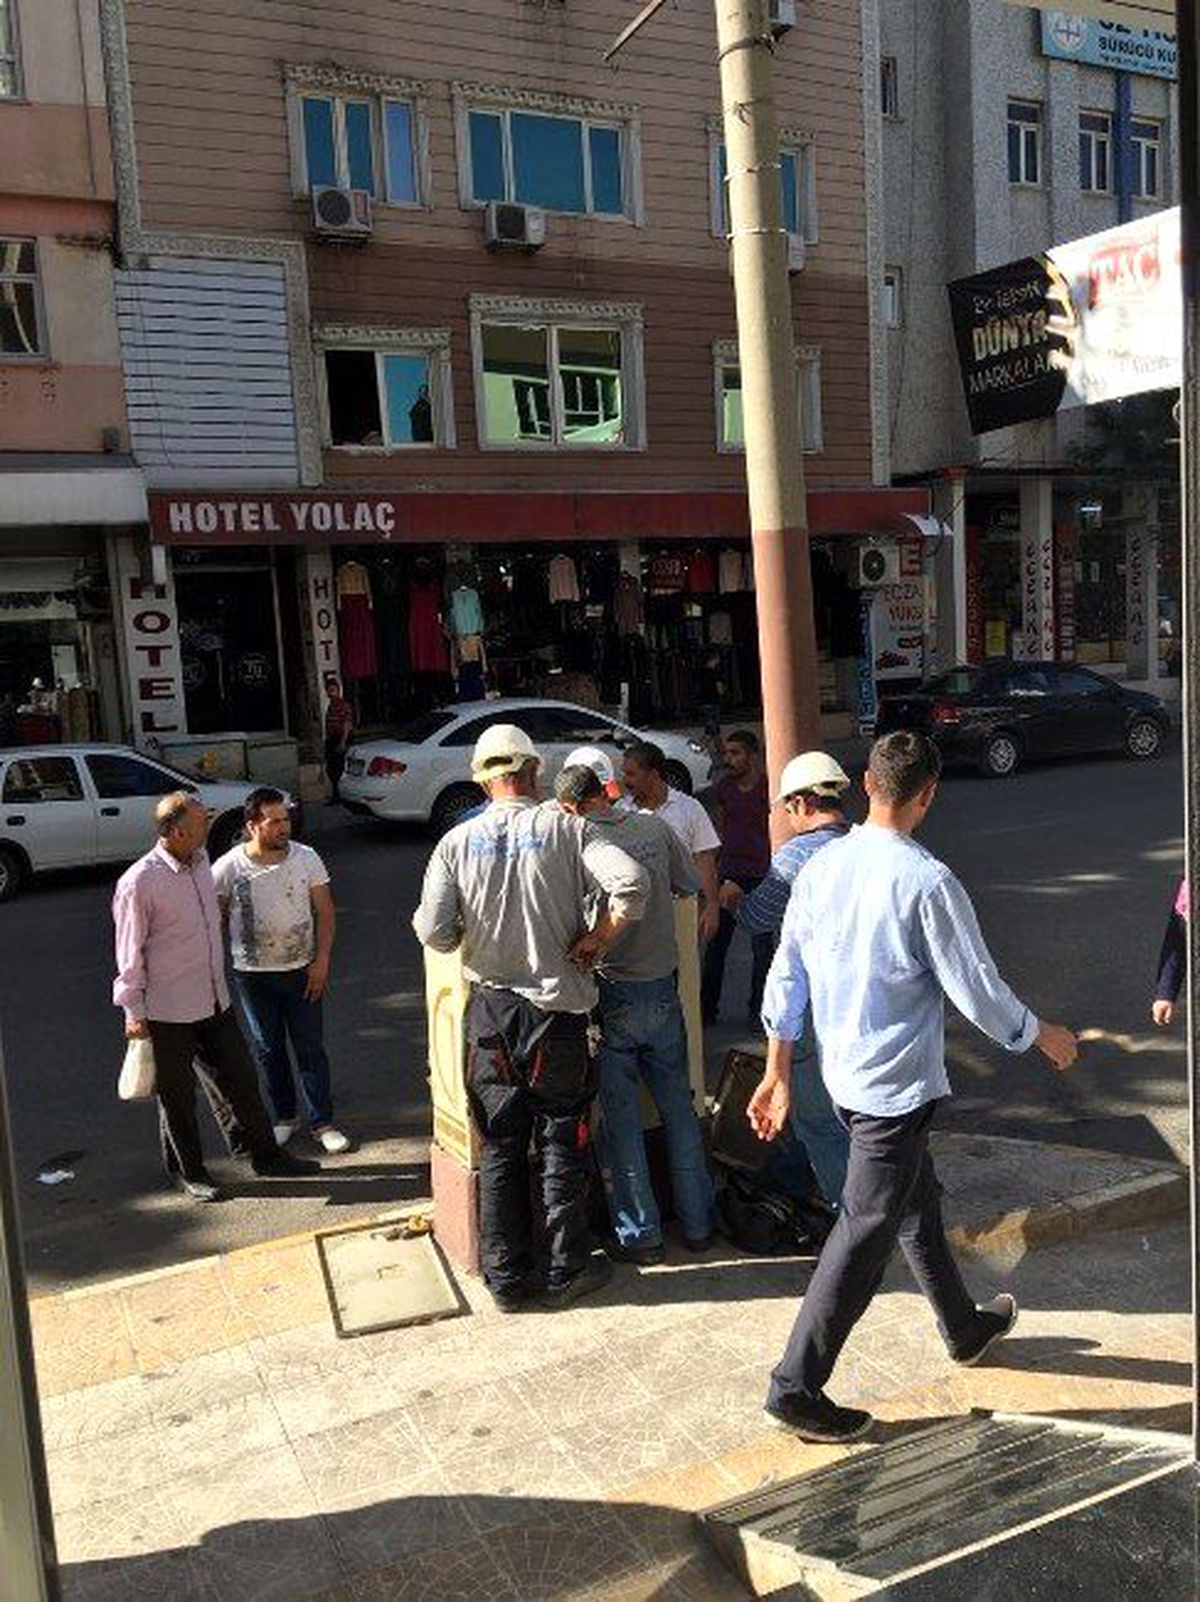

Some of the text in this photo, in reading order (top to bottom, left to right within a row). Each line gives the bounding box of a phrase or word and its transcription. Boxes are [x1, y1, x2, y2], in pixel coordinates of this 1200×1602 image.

[972, 309, 1049, 361] DÜNYA
[168, 501, 396, 539] HOTEL YOLAÇ
[129, 576, 178, 733] HOTEL
